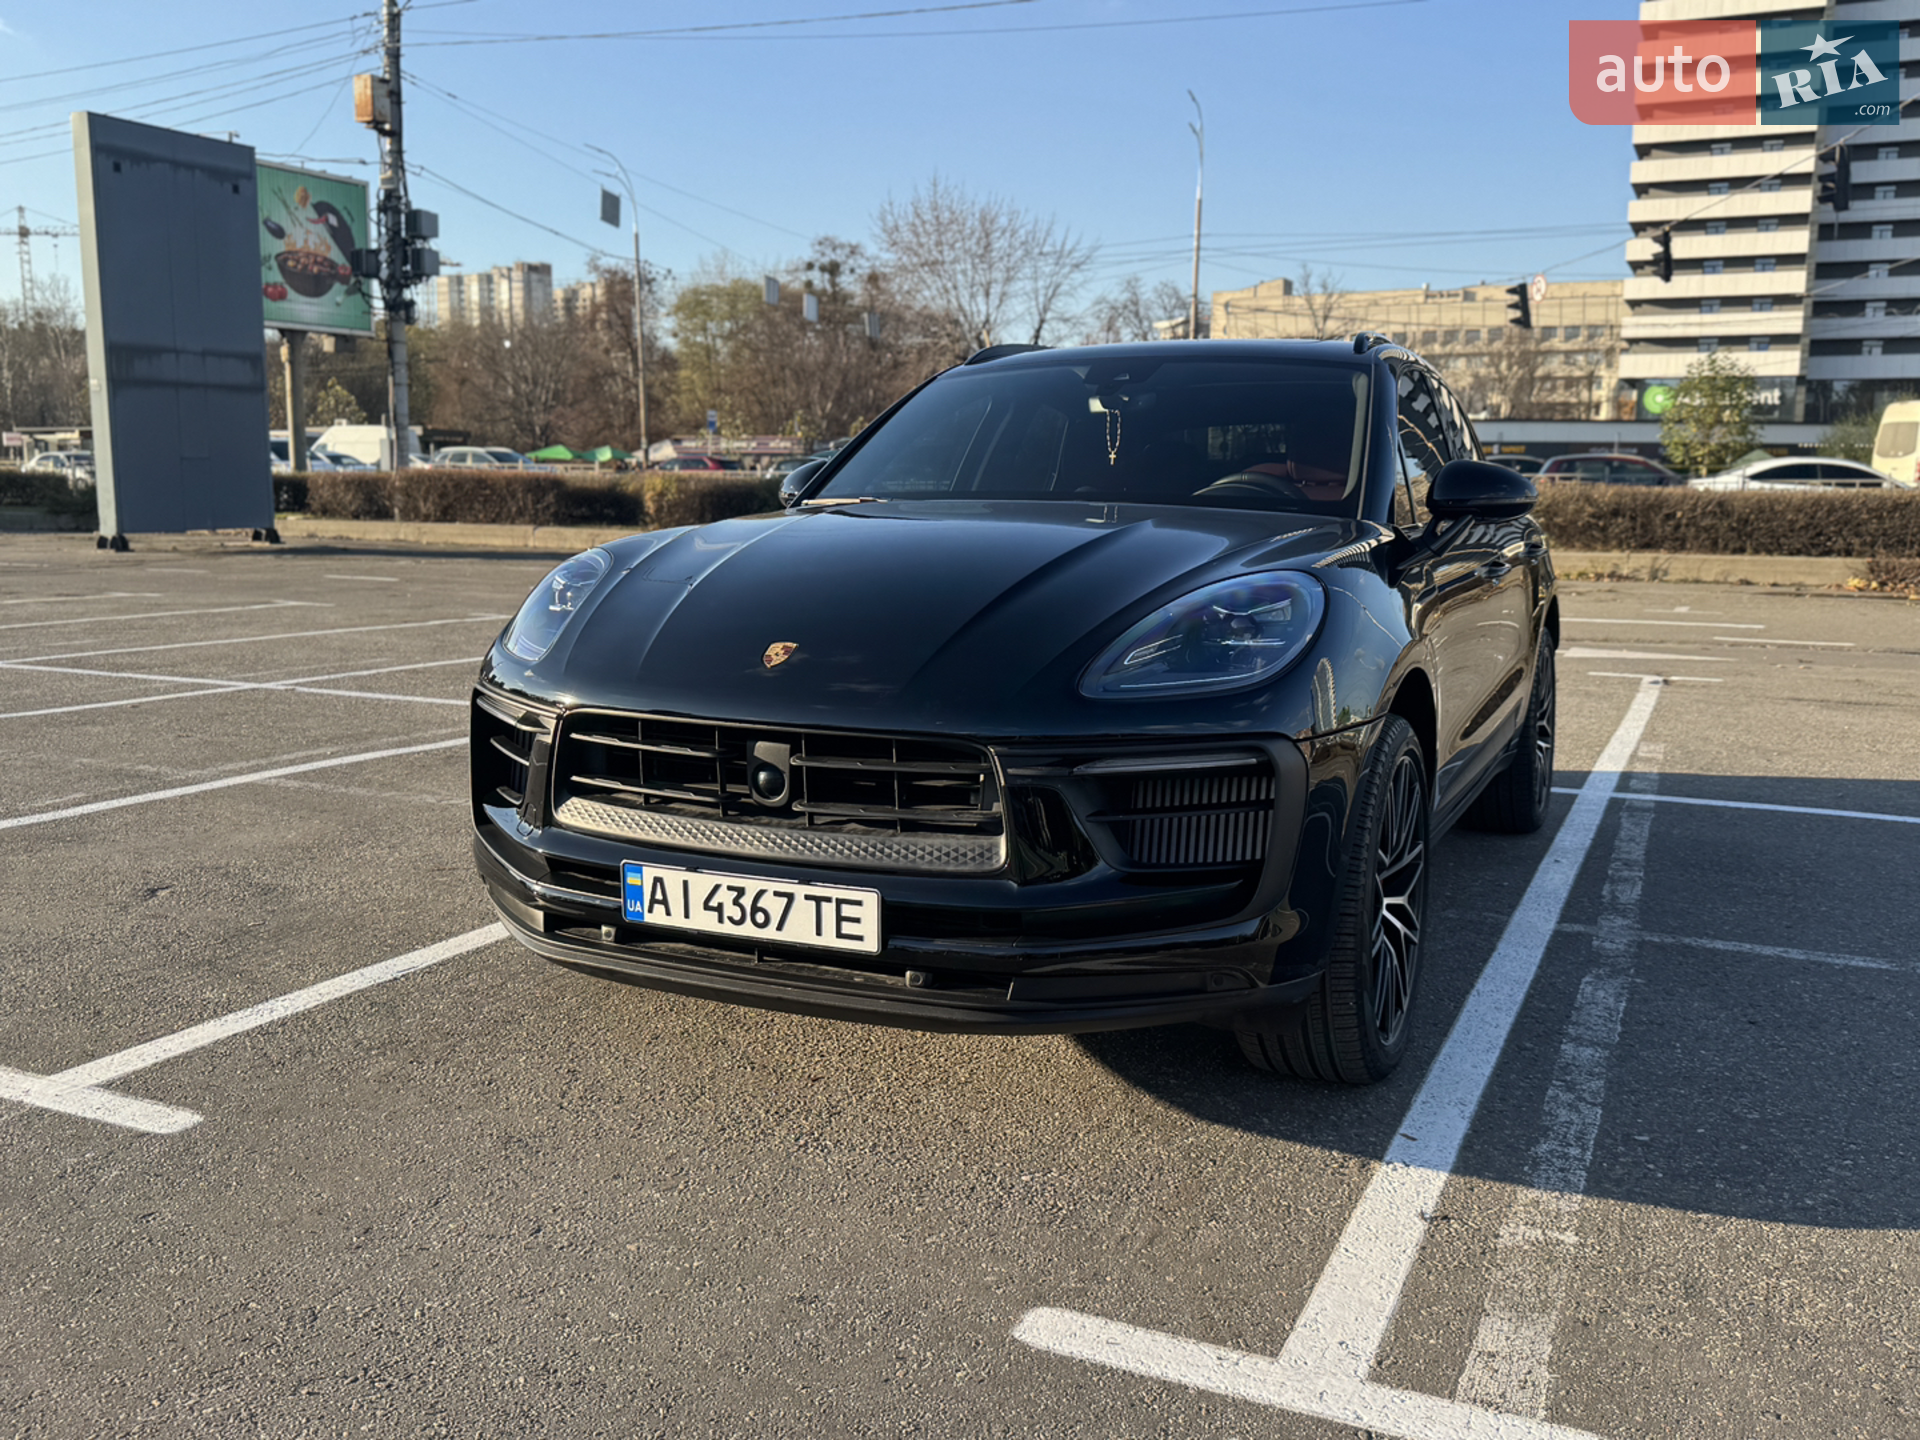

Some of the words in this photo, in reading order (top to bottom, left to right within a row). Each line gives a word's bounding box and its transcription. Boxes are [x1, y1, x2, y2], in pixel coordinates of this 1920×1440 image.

[627, 899, 643, 913] UA
[647, 875, 690, 919] AI
[703, 883, 796, 931] 4367
[803, 894, 865, 942] TE
